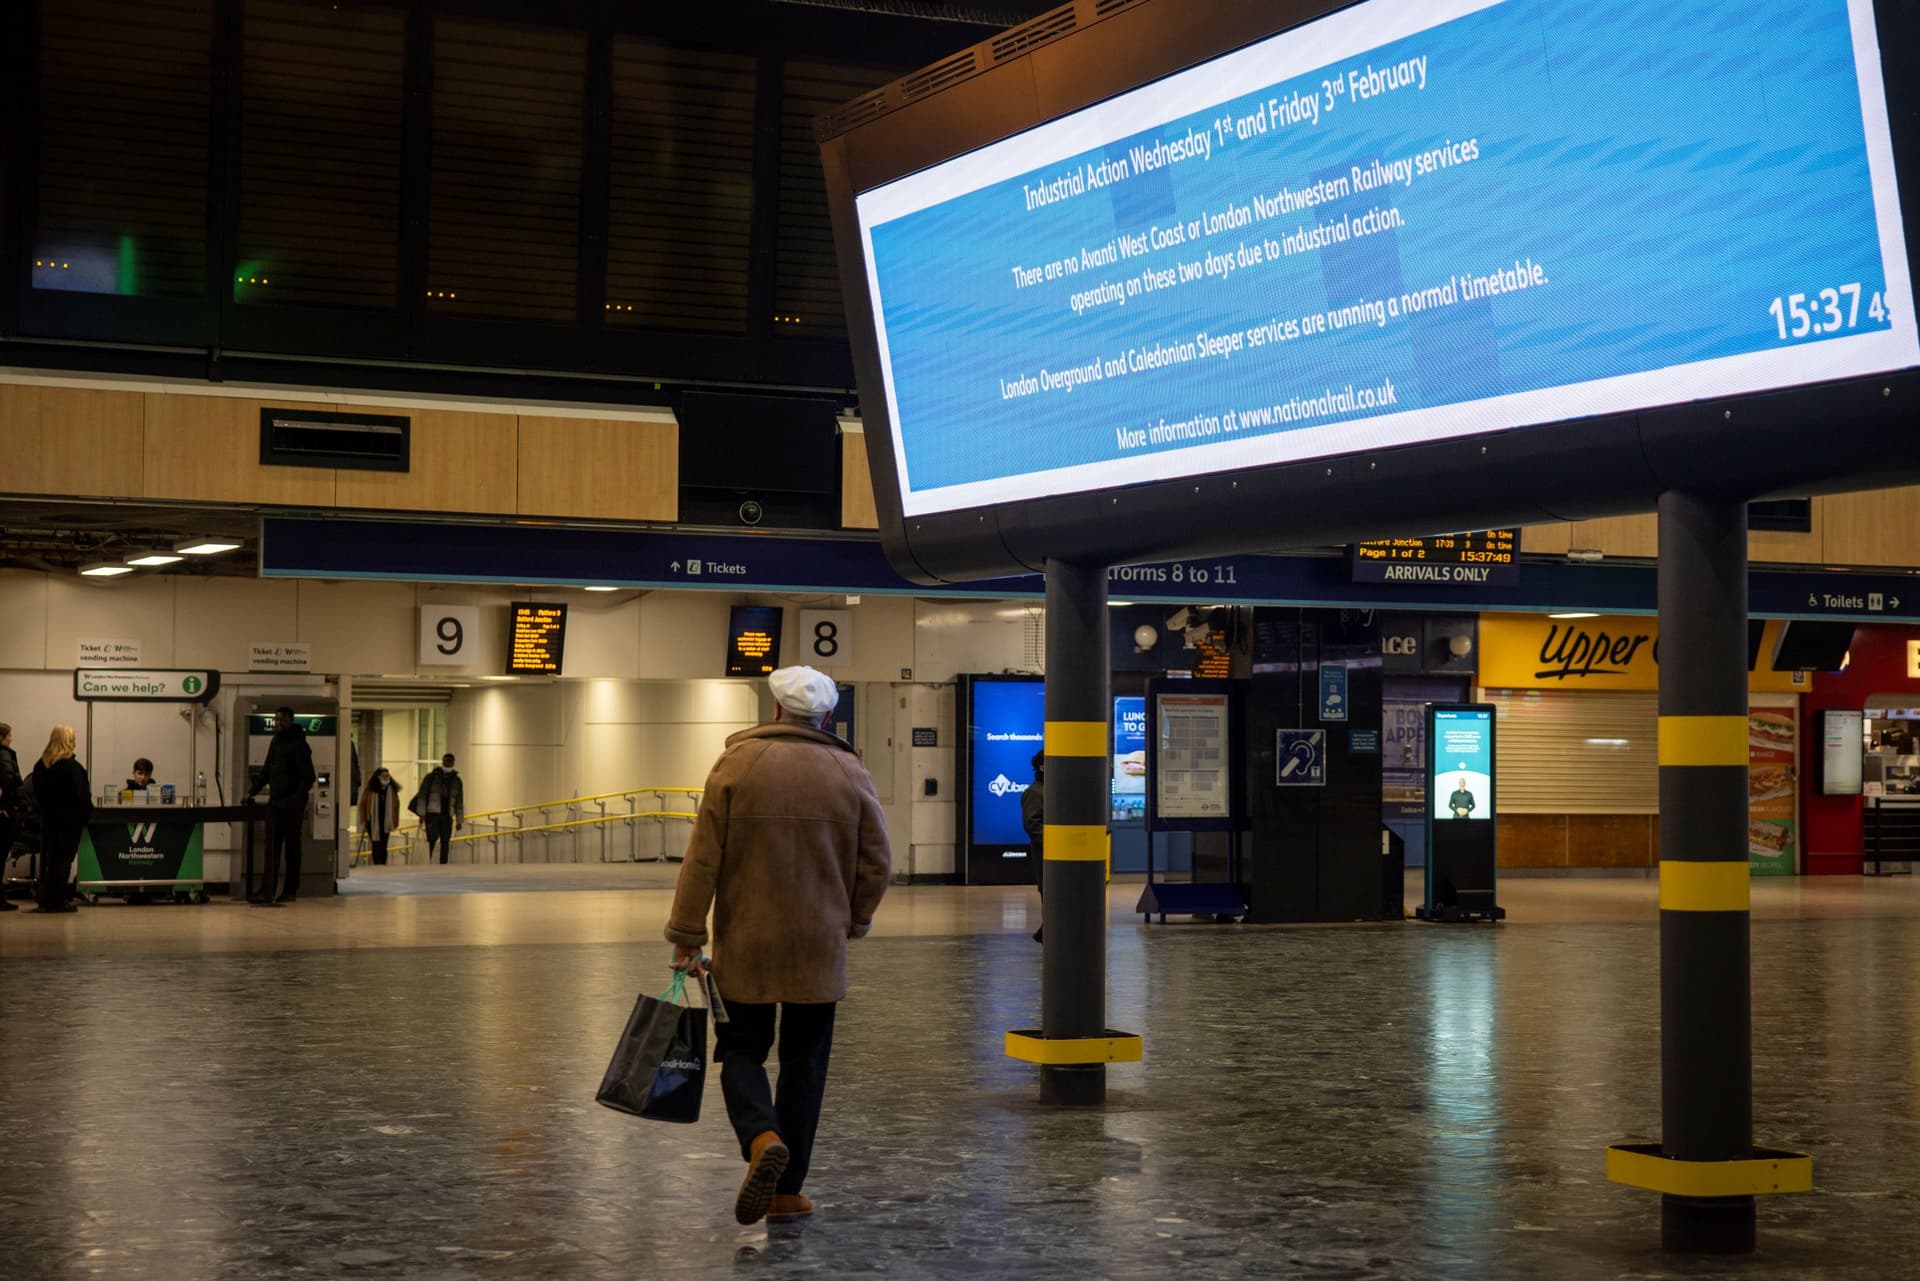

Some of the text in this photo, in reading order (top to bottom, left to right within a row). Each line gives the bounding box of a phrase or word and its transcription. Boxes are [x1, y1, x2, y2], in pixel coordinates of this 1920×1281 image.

[1023, 55, 1427, 211] Industrial Action Wednesday 1st and Friday 3rd February
[1012, 137, 1480, 289] There are no Avanti West Coast or London Northwestern Railway services
[1070, 206, 1406, 315] operating on these two days due to industrial action.
[1768, 282, 1862, 340] 15:37
[1001, 257, 1550, 400] London Overground and Caledonian Sleeper services are running a normal timetable.
[1116, 377, 1397, 450] More information at www.nationalrail.co.uk
[1360, 548, 1511, 563] Page 1 of 2 15:37:49
[706, 562, 746, 575] Tickets
[1171, 564, 1183, 582] 8
[1189, 566, 1208, 583] to
[1214, 565, 1237, 584] 11
[1385, 565, 1490, 582] ARRIVALS ONLY
[1823, 594, 1863, 608] Toilets
[436, 617, 463, 655] 9
[813, 621, 838, 657] 8
[80, 644, 101, 652] Ticket
[1540, 624, 1649, 680] Upper
[80, 655, 107, 663] vending
[83, 681, 166, 695] Can we help?
[1123, 712, 1145, 721] LUNC
[1123, 722, 1145, 731] TO G
[1386, 727, 1424, 743] APPE
